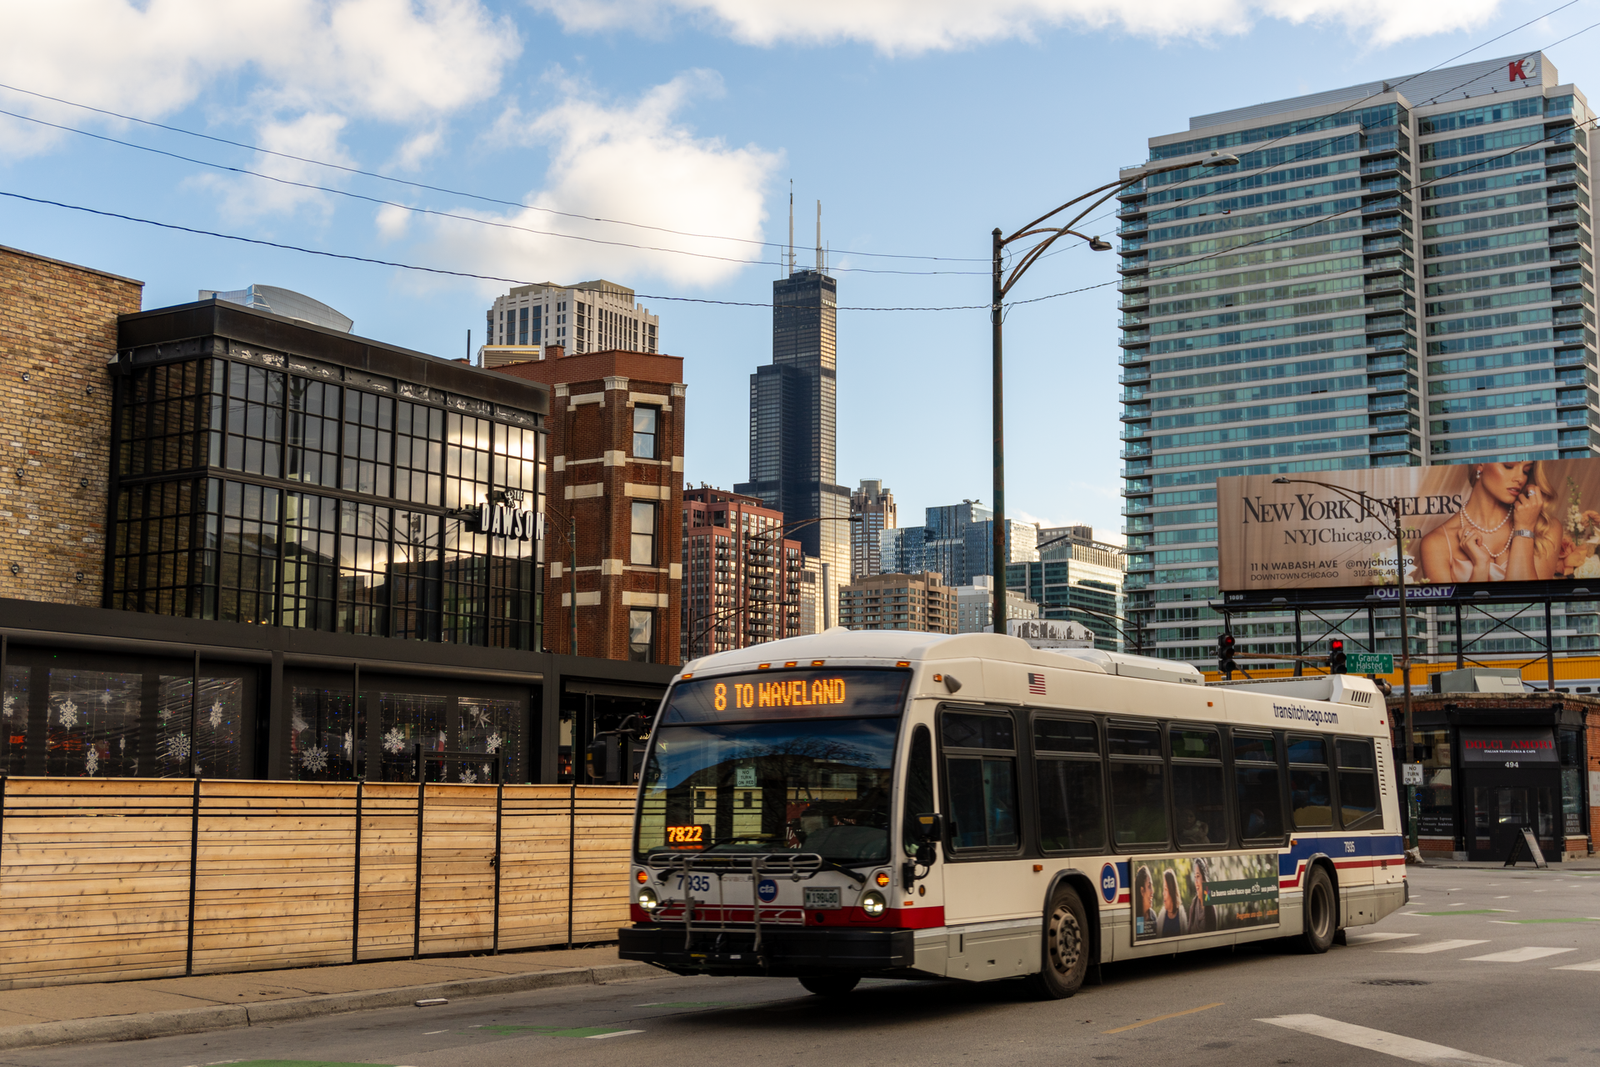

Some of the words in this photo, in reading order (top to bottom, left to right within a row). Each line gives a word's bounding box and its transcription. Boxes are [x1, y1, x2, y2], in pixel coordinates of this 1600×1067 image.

[1509, 57, 1537, 82] K2
[513, 489, 524, 501] THE
[1242, 495, 1296, 524] NEW
[1295, 493, 1355, 521] YORK
[1355, 490, 1463, 524] JEWELERS
[480, 502, 545, 541] DAWSON
[1250, 562, 1259, 572] 11
[1261, 562, 1269, 571] N
[1271, 560, 1316, 571] WABASH
[1318, 559, 1338, 569] AVE
[1250, 572, 1300, 582] DOWNTOWN
[1300, 570, 1339, 580] CHICAGO
[1358, 653, 1380, 662] Grand
[1356, 661, 1383, 670] Halsted
[714, 683, 727, 711] 8
[734, 683, 754, 709] TO
[758, 678, 846, 708] WAVELAND
[1273, 702, 1339, 727] transitchicago.com
[1464, 739, 1504, 750] DOLCI
[1510, 739, 1554, 750] AMORI
[666, 825, 703, 843] 7822
[1102, 875, 1116, 889] cta
[759, 884, 775, 894] cta
